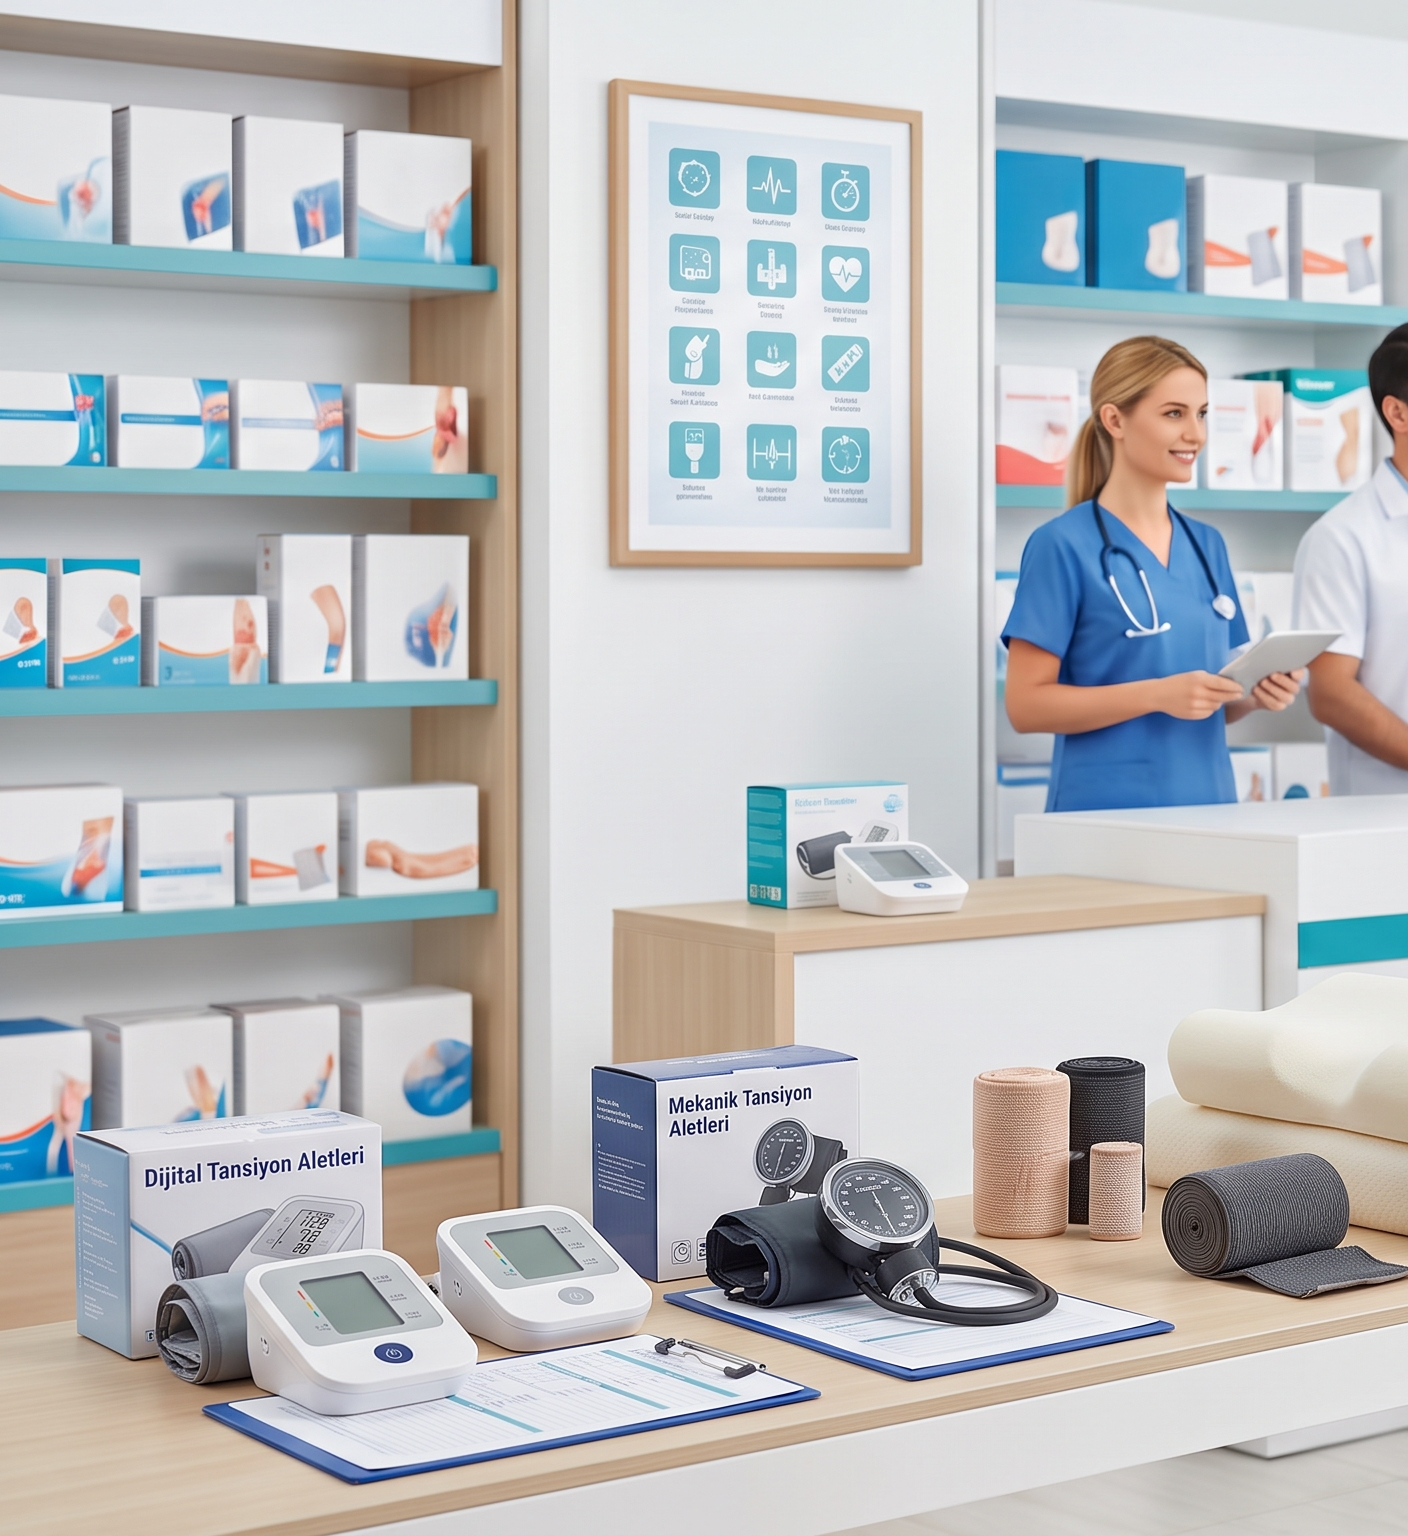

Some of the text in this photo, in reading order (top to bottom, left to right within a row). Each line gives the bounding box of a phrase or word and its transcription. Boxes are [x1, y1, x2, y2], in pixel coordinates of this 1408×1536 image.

[668, 1091, 738, 1115] Mekanik
[743, 1085, 812, 1107] Tansiyon
[668, 1115, 729, 1138] Aletleri
[144, 1145, 365, 1191] Dijital Tansiyon Aletleri
